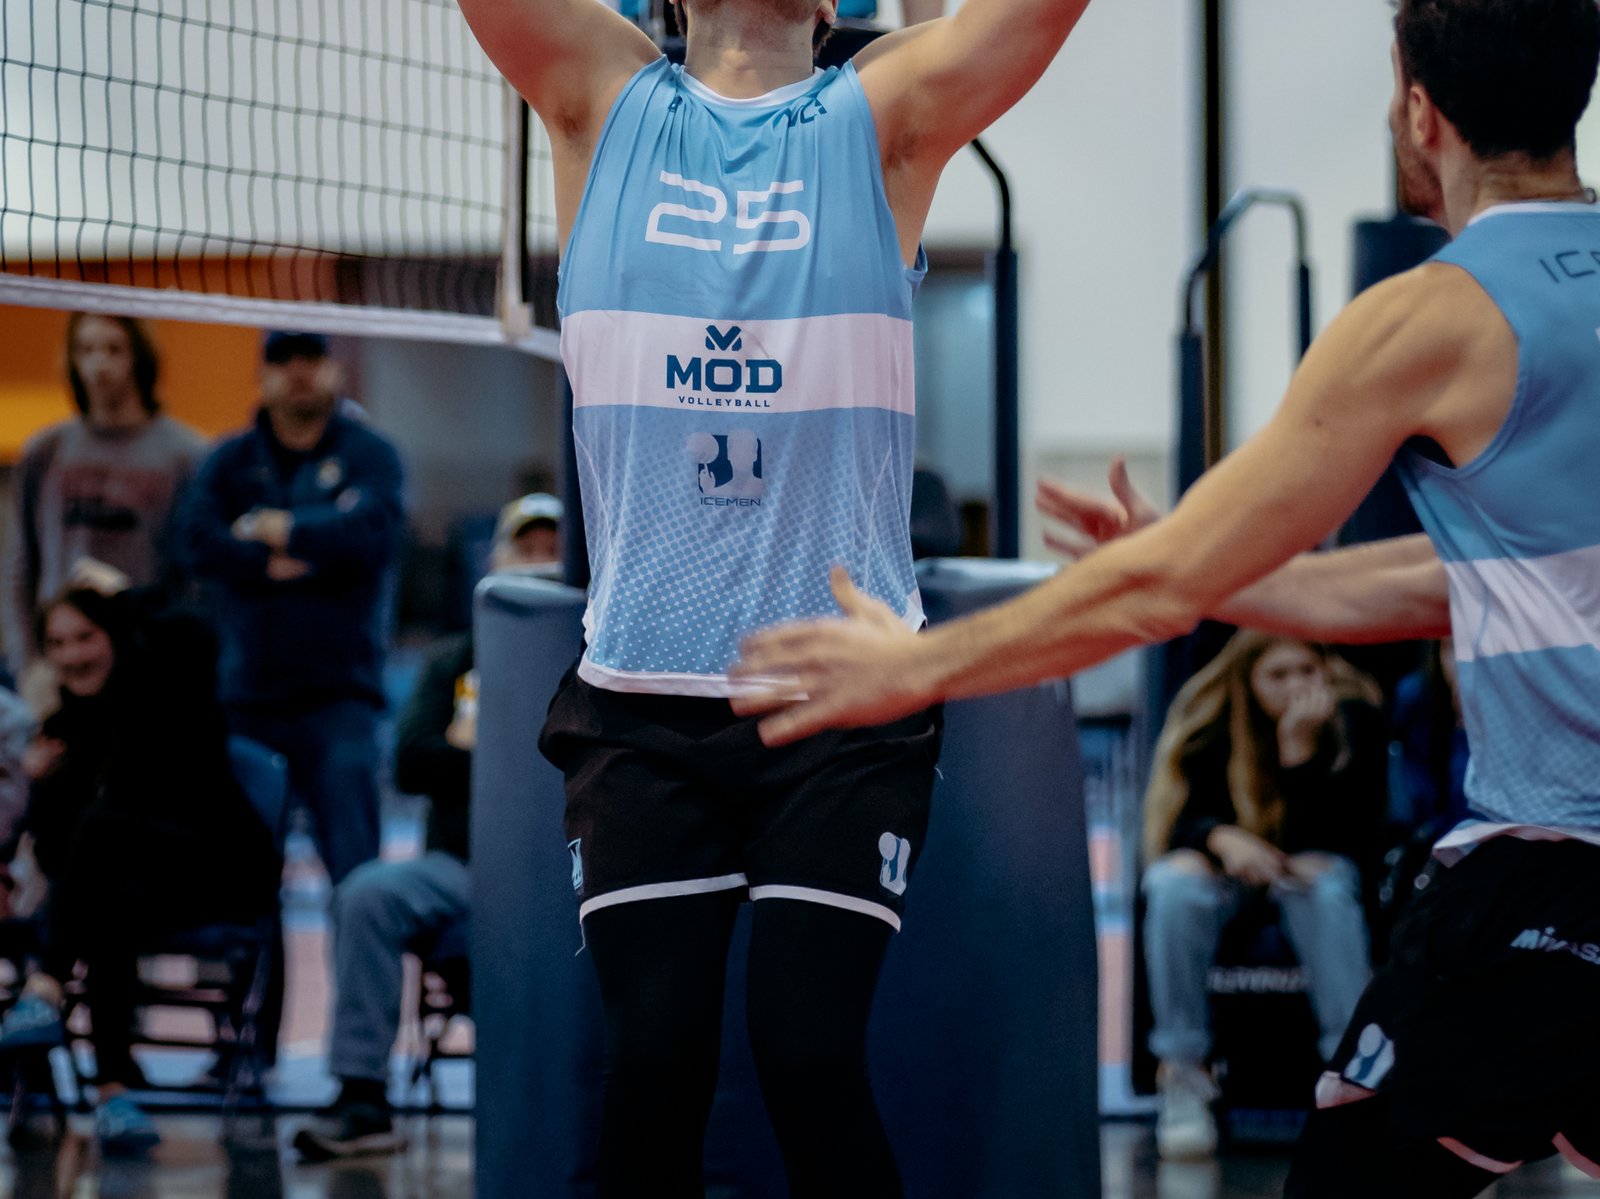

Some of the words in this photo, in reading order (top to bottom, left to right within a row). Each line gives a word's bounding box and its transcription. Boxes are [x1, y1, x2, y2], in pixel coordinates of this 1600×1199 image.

[645, 170, 811, 255] 25
[1539, 250, 1600, 284] IC
[666, 354, 783, 393] MOD
[678, 395, 771, 407] VOLLEYBALL
[700, 496, 761, 507] ICEMEN
